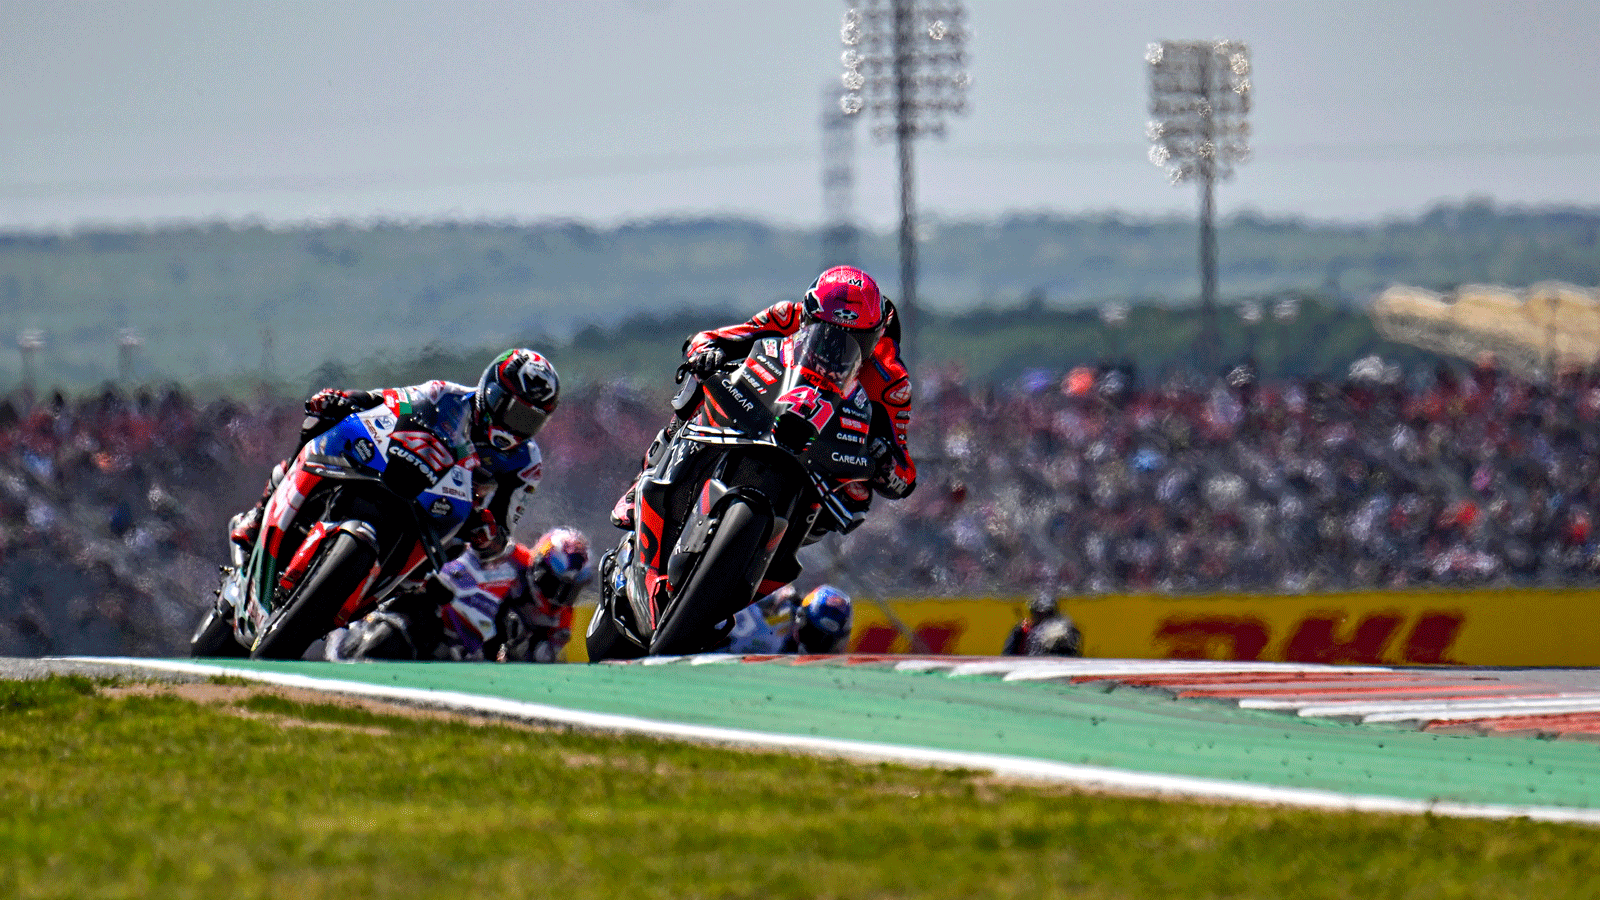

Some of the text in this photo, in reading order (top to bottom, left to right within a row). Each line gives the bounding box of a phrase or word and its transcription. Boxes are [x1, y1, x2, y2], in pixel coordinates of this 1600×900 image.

[721, 379, 754, 412] CAREAR
[774, 385, 835, 434] 41
[836, 432, 858, 443] CASE
[388, 446, 439, 485] CUSTOM
[831, 452, 868, 467] CAREAR
